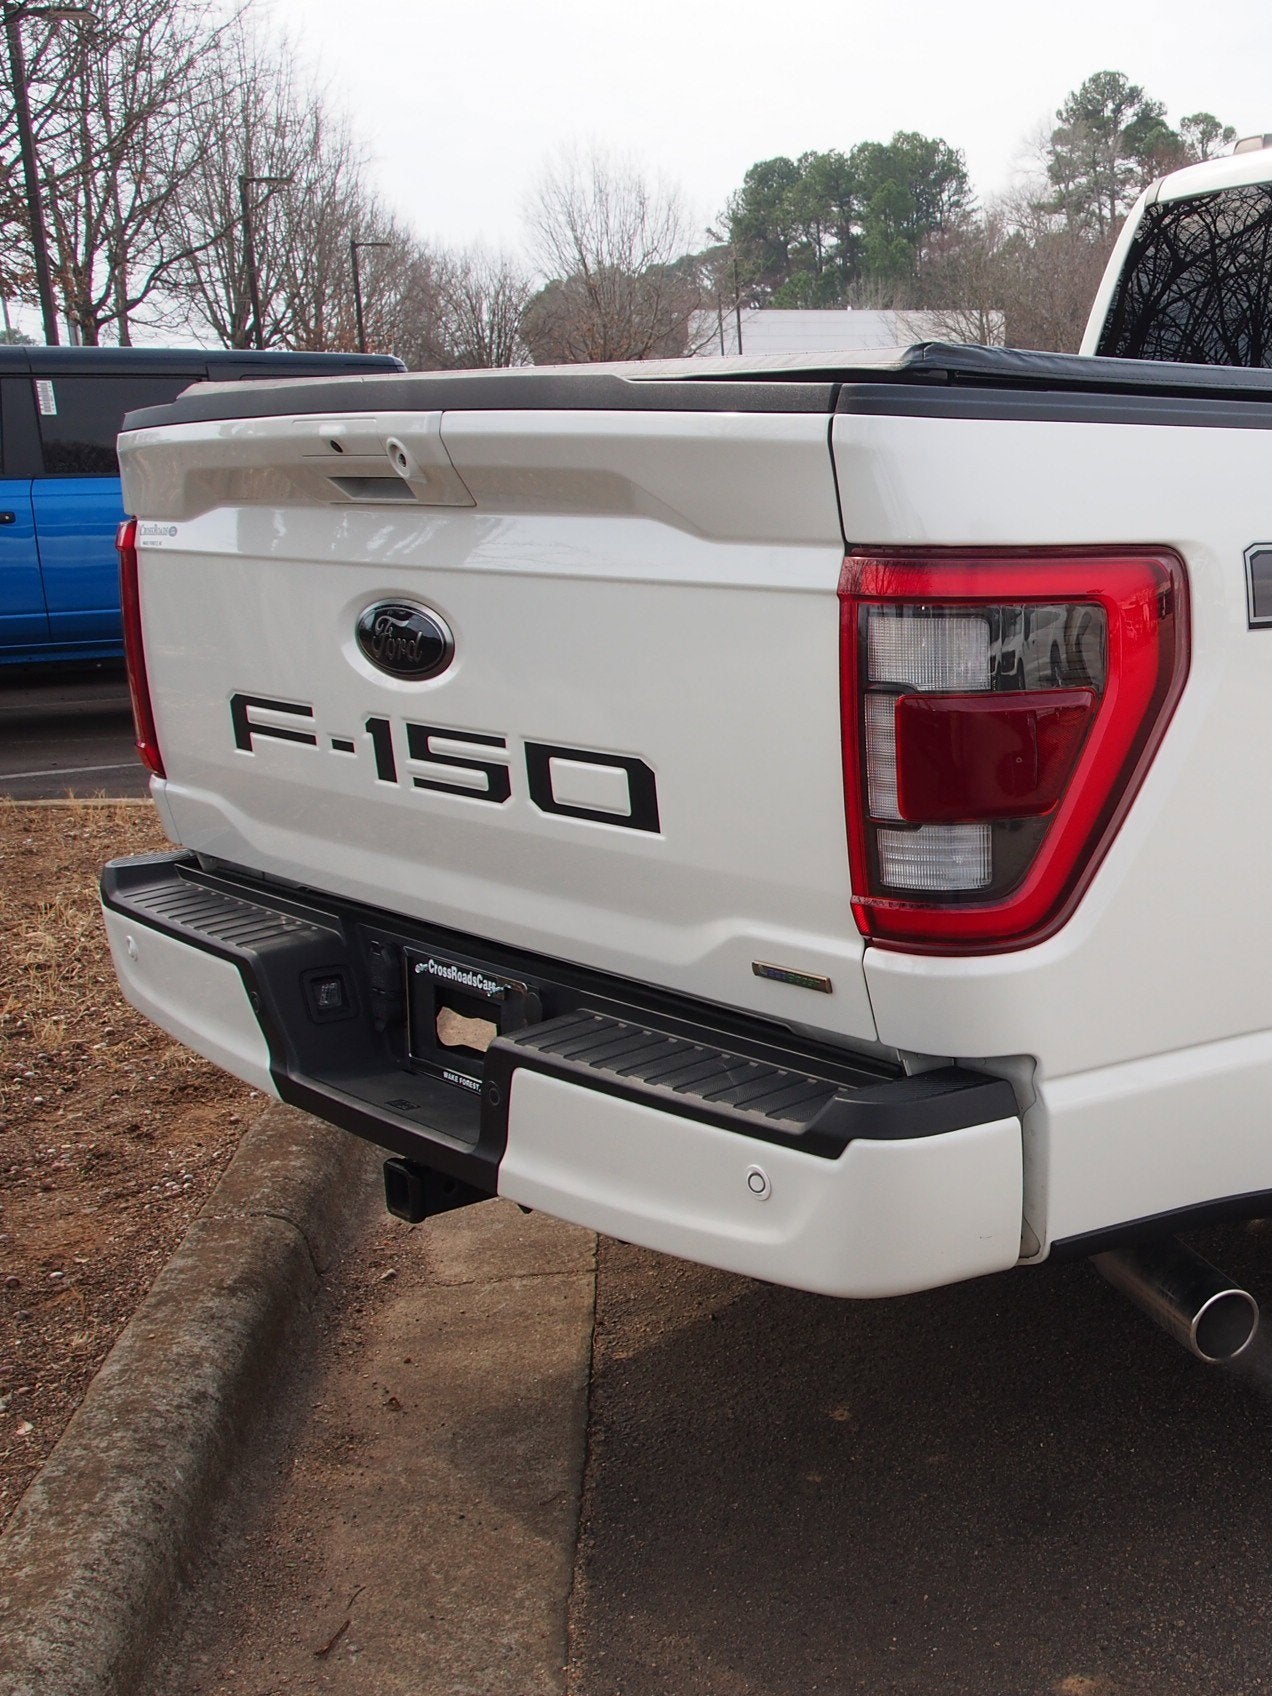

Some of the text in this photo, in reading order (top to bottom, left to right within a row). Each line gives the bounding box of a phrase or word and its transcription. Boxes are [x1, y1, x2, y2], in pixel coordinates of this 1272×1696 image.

[371, 614, 423, 663] Ford
[231, 693, 661, 834] F-150
[443, 1071, 459, 1083] WAKE
